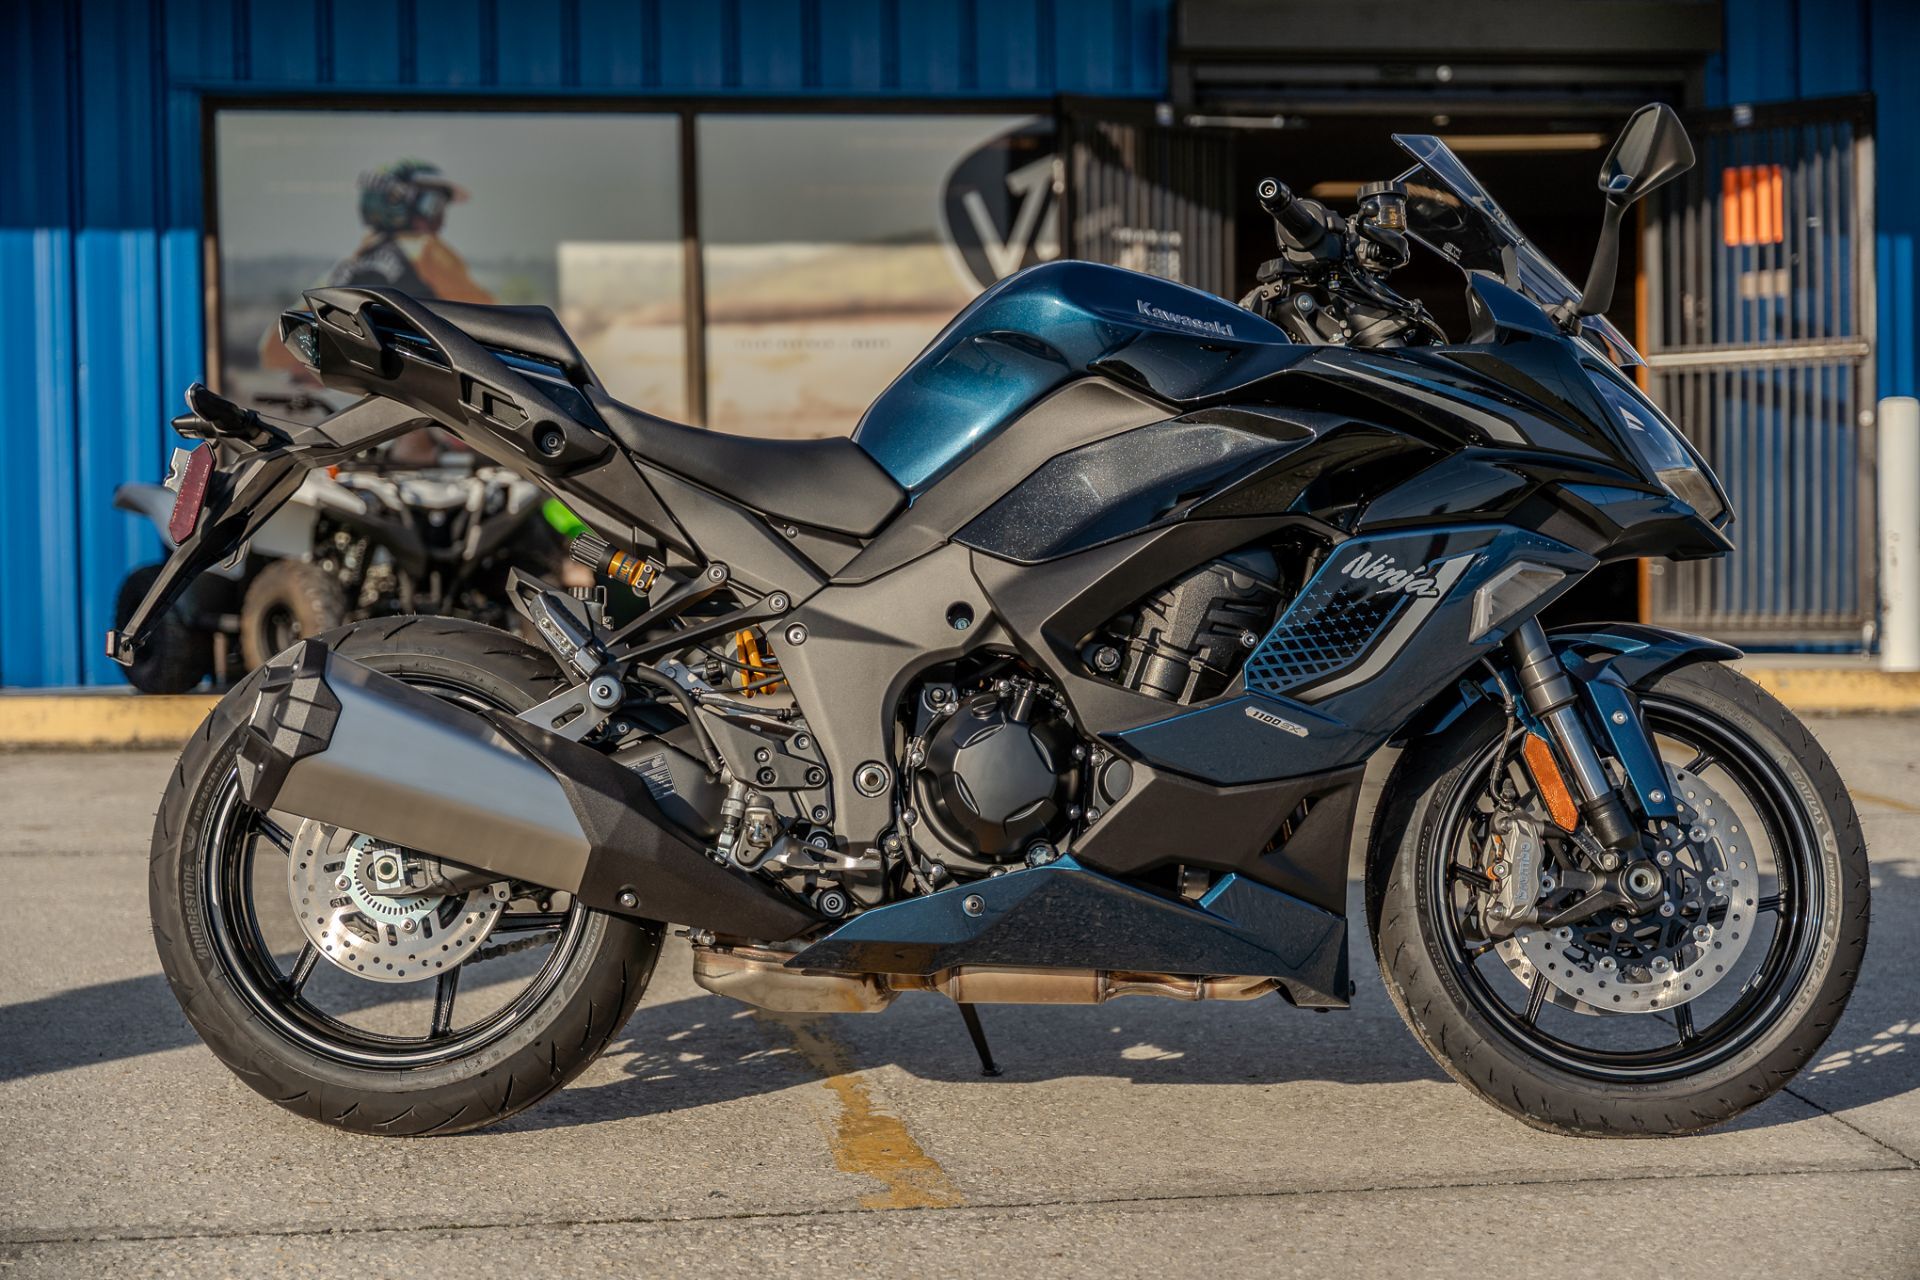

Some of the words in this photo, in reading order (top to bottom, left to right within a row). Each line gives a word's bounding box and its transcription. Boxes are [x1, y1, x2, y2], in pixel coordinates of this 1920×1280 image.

[1137, 299, 1234, 337] Kawasaki
[1341, 551, 1438, 596] Ninja
[1790, 769, 1825, 825] BATTLAX
[1516, 841, 1532, 901] brembo
[182, 863, 211, 961] BRIDGESTONE
